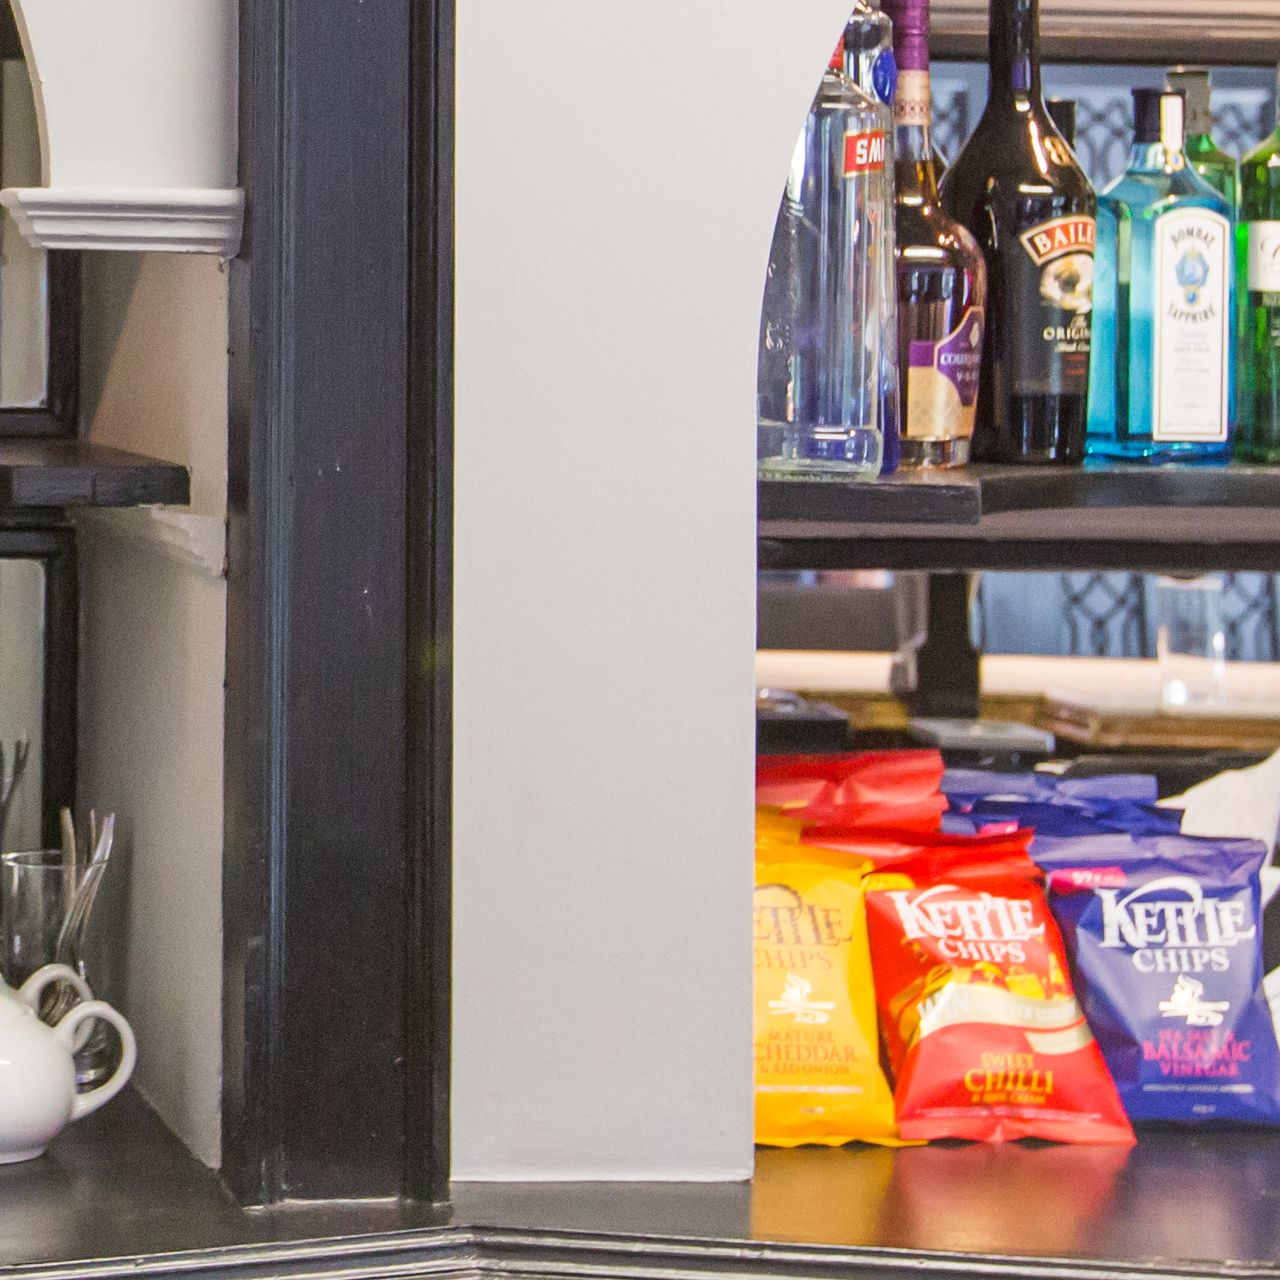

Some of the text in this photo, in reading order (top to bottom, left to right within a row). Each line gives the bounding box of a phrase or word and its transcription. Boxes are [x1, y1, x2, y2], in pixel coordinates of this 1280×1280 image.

[1034, 222, 1095, 255] BAILE
[1171, 227, 1215, 248] BOMBAY
[753, 884, 853, 946] ETTLE
[885, 884, 1046, 942] KETTLE
[1095, 876, 1256, 948] KETTLE
[938, 938, 1026, 962] CHIPS
[1132, 947, 1230, 972] CHIPS
[769, 1031, 834, 1043] MATURE
[1143, 1040, 1252, 1062] BALSAMIC
[964, 1068, 1053, 1093] CHILLI
